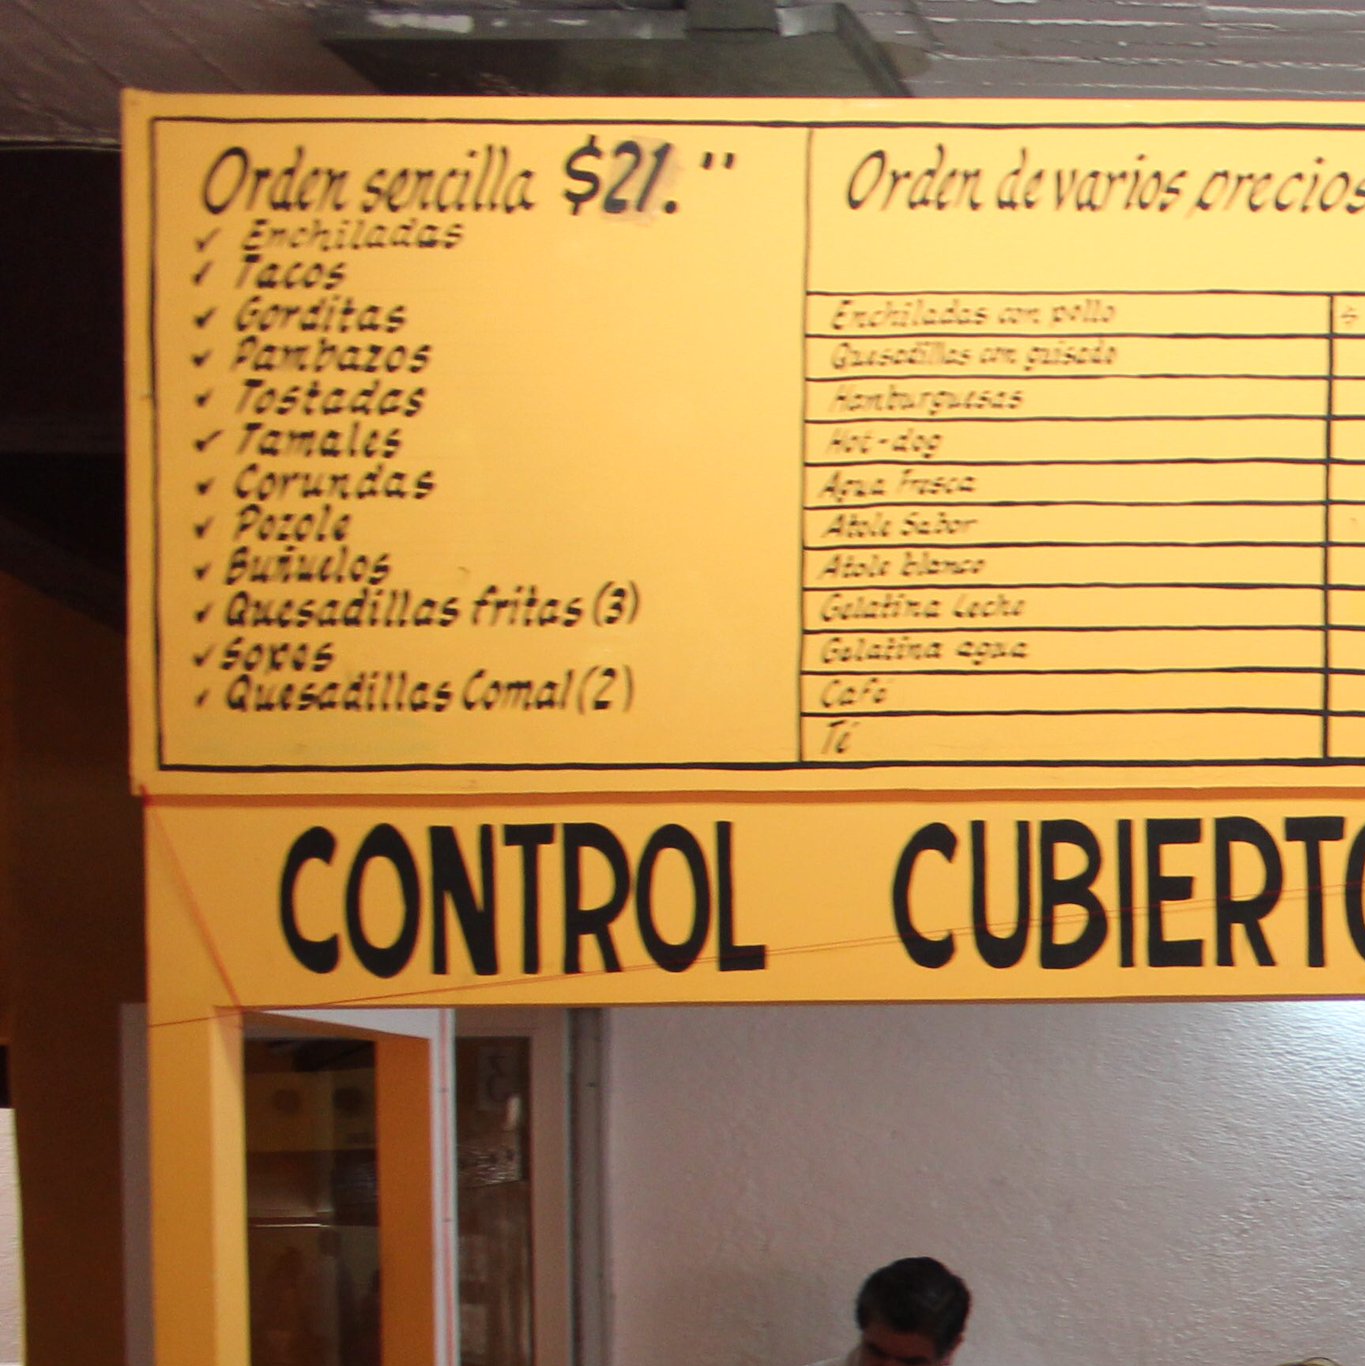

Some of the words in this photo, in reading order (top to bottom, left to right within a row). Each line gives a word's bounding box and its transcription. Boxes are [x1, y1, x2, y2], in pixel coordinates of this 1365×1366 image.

[203, 146, 348, 215] Orden
[362, 145, 536, 214] sencilla
[846, 145, 983, 212] Orden
[241, 218, 464, 251] Enchiladas
[234, 253, 346, 290] Tacos
[236, 295, 407, 333] Gorditas
[830, 299, 988, 330] Enchiladas
[998, 307, 1041, 325] con
[1050, 299, 1116, 327] pollo
[230, 335, 432, 373] Pambazos
[830, 340, 972, 370] Quesadillas
[978, 346, 1018, 366] con
[234, 378, 426, 417] Tostadas
[828, 384, 1024, 416] Hamburguesas
[235, 421, 402, 459] Tamales
[233, 463, 436, 500] Corundas
[818, 469, 886, 503] Agua
[232, 504, 352, 541] Pozole
[820, 512, 891, 539] Atole
[224, 546, 391, 585] Buñuelos
[817, 552, 891, 580] Atole
[224, 587, 460, 628] Quesadillas
[470, 584, 584, 627] fritas
[592, 580, 641, 628] (3)
[821, 592, 942, 623] Gelatina
[822, 635, 943, 665] Gelatina
[225, 671, 454, 714] Quesadillas
[575, 663, 636, 716] (2)
[279, 820, 767, 977] CONTROL
